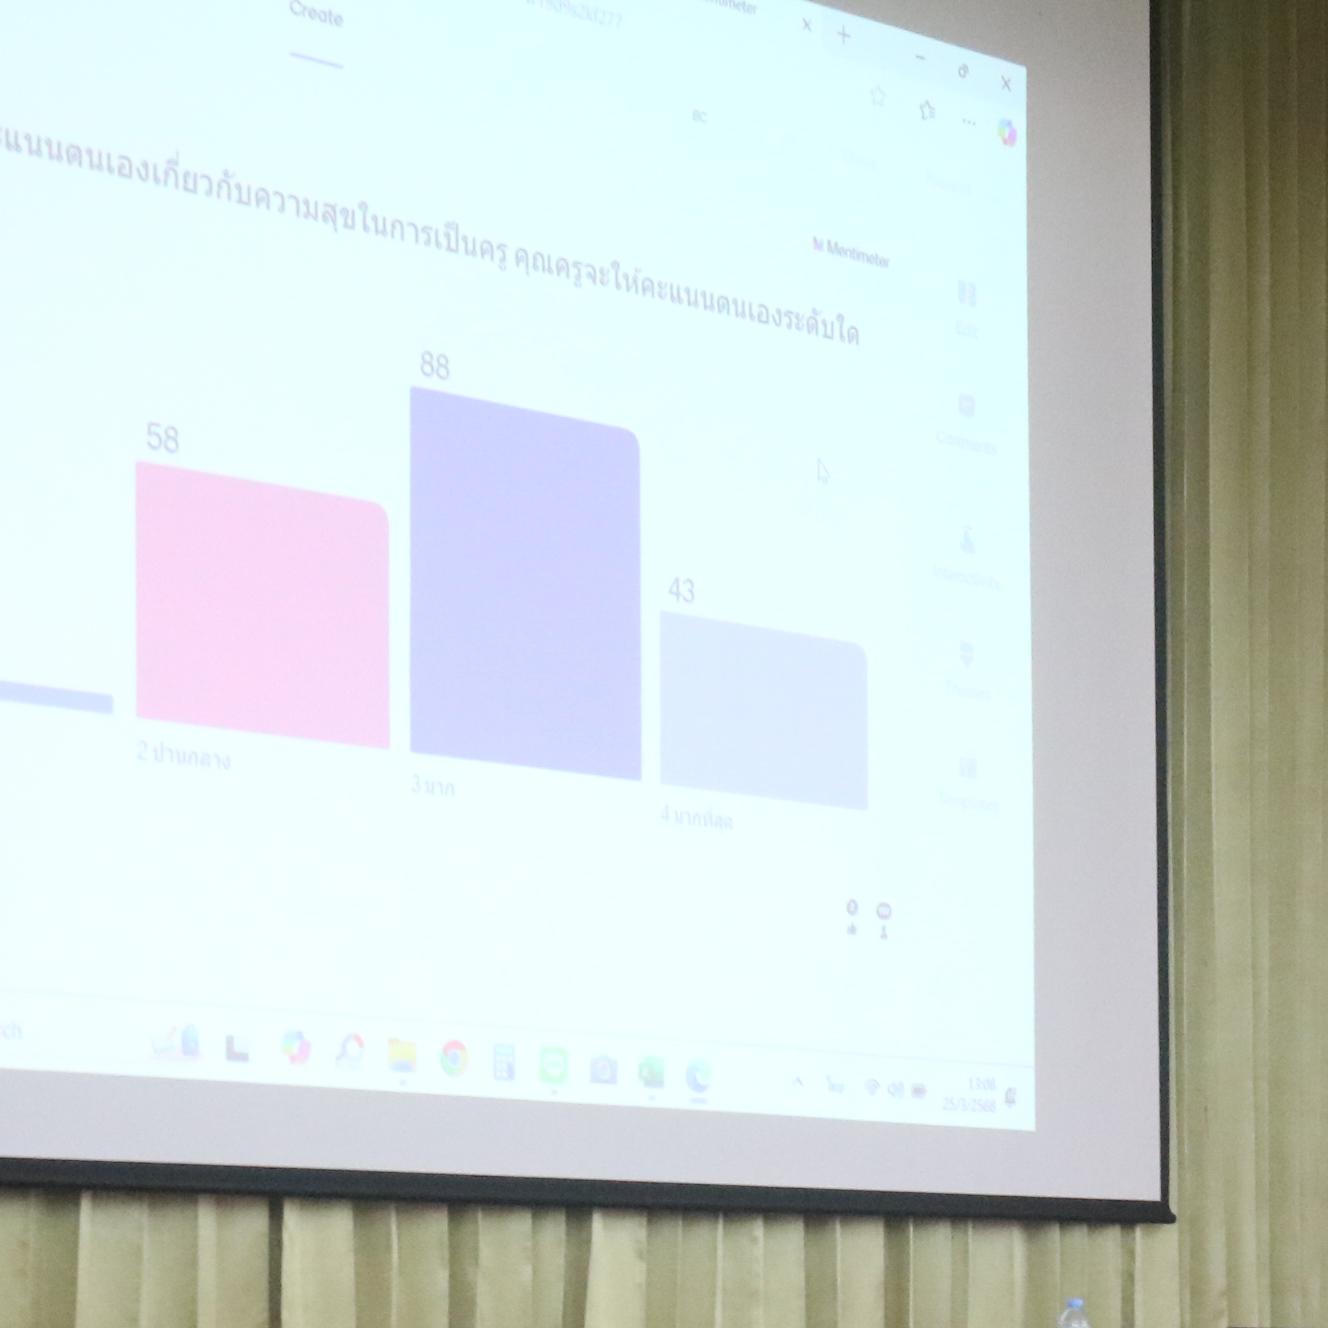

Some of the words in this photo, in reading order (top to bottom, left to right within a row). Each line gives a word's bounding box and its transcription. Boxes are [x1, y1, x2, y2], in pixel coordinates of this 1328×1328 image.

[288, 0, 344, 27] Create
[826, 239, 891, 268] Mentimeter
[420, 351, 450, 380] 88
[146, 421, 180, 453] 58
[668, 576, 696, 604] 43
